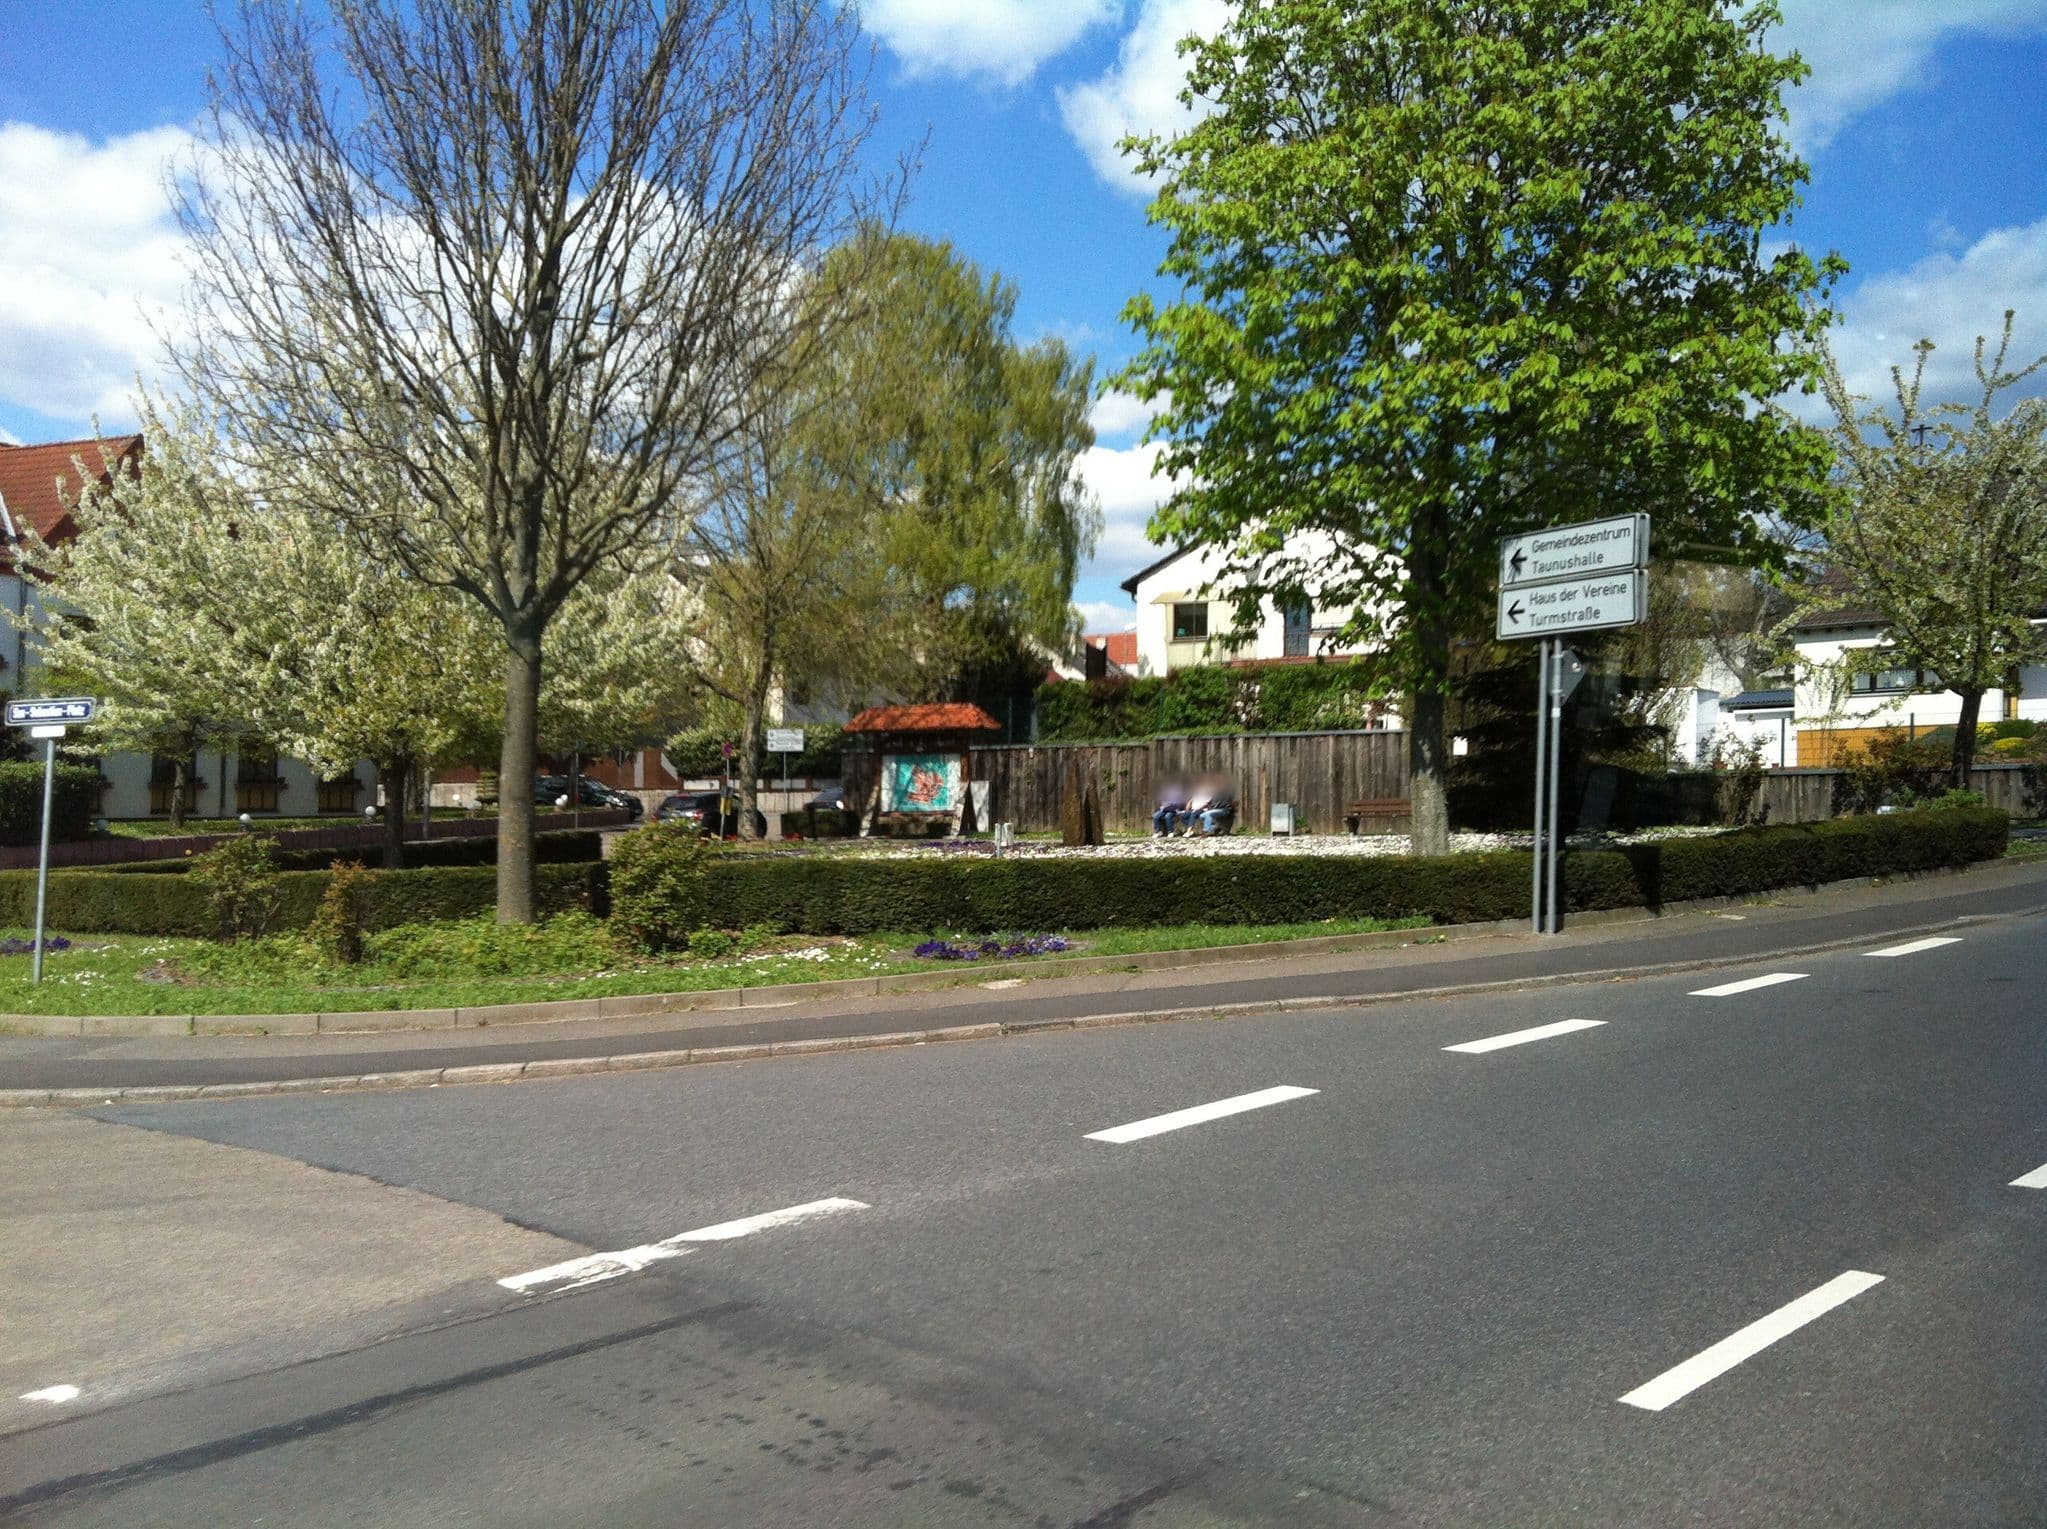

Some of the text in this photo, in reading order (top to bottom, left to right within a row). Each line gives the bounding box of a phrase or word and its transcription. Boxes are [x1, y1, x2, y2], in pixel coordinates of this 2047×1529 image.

[1532, 527, 1631, 553] Gemeindezentrum
[1532, 552, 1604, 574] Taunushalle
[1530, 582, 1627, 606] Haus der Vereine
[1530, 606, 1601, 627] Turmstraße
